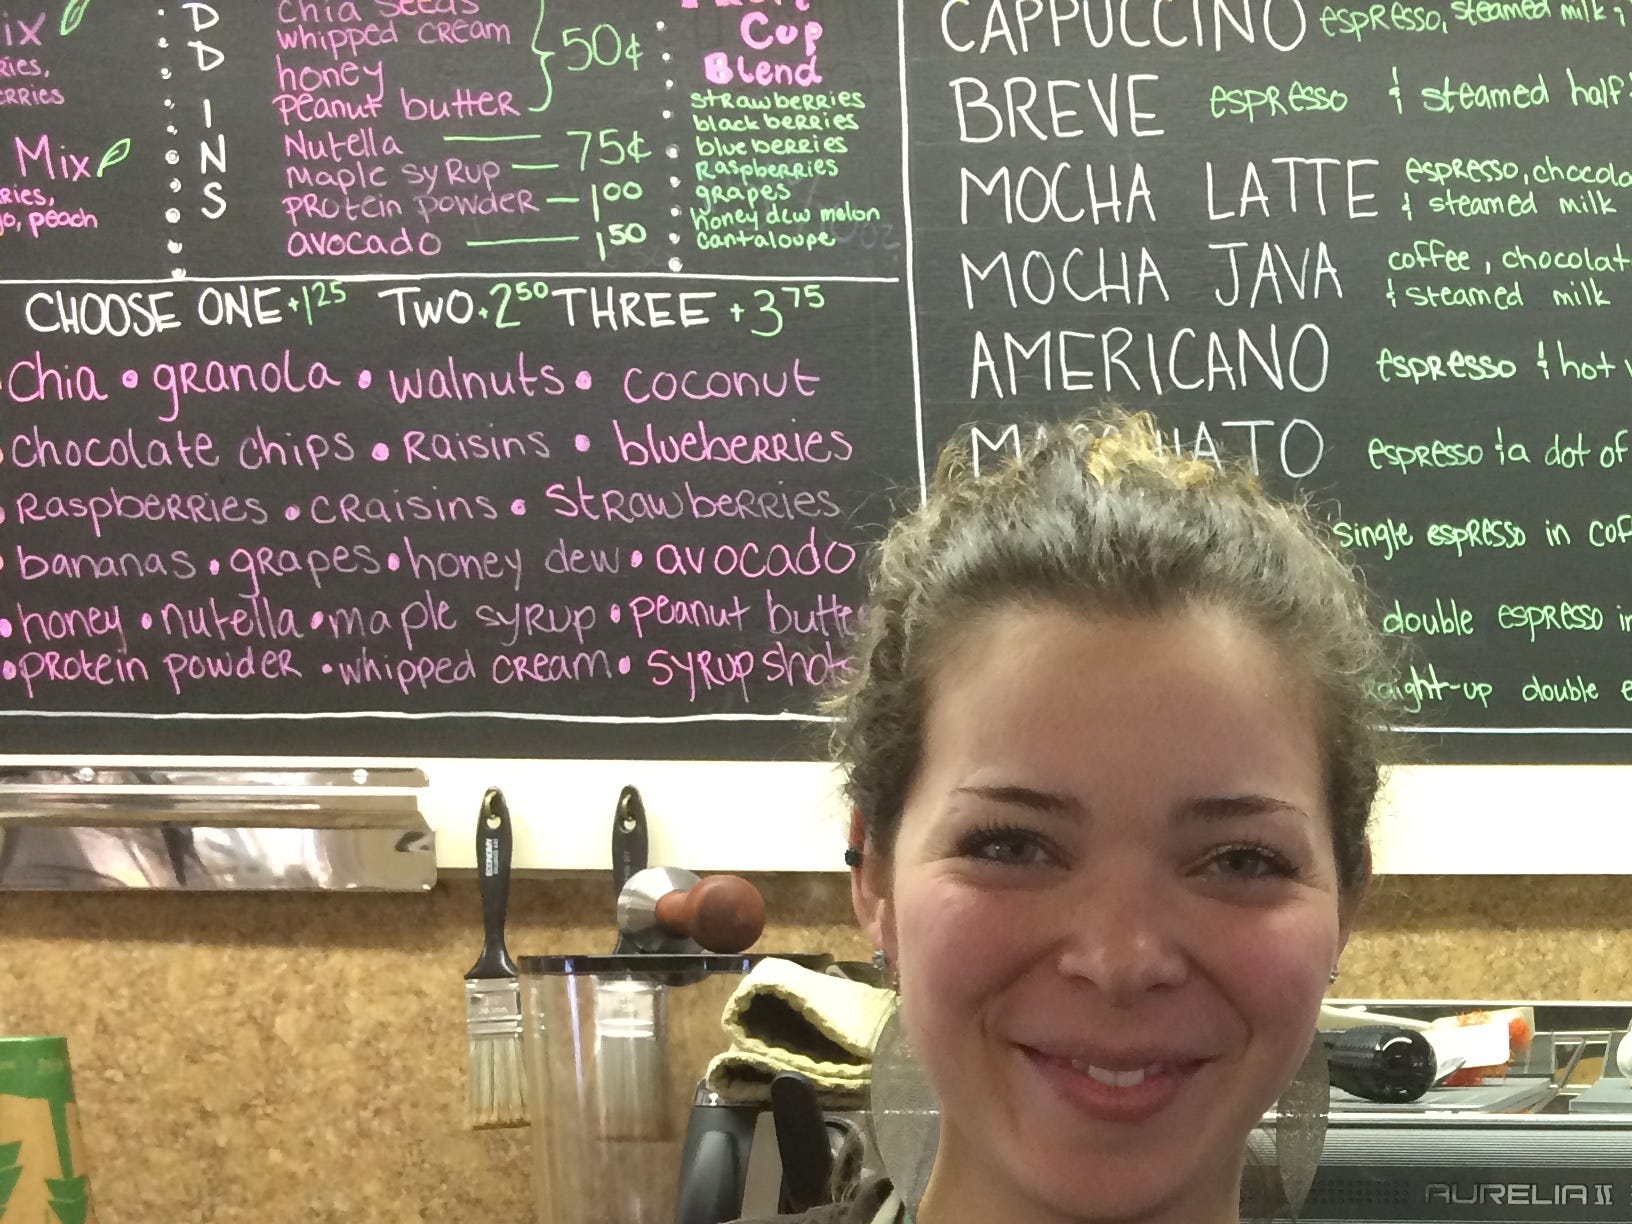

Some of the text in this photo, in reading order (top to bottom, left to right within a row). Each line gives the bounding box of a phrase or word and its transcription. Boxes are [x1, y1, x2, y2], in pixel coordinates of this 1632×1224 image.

[277, 19, 511, 59] whipped cream
[740, 11, 823, 56] Cup
[941, 0, 1307, 55] CAPPUCCINO
[277, 54, 383, 98] honey
[704, 52, 823, 86] Blend
[273, 88, 520, 126] Peanut butter
[690, 89, 866, 109] strawberries
[950, 73, 1164, 142] BREVE
[1210, 81, 1347, 122] espresso
[1422, 73, 1549, 112] steamed
[15, 134, 91, 181] Mix
[284, 129, 402, 157] Nutella
[284, 197, 401, 226] protein
[417, 187, 539, 225] powder
[696, 182, 791, 216] grapes
[961, 157, 1379, 225] MOCHA LATTE
[1429, 189, 1617, 217] steamed milk
[29, 207, 98, 238] peach
[821, 205, 879, 222] melon
[288, 229, 441, 257] avocado
[697, 229, 836, 249] cantaloupe
[961, 241, 1342, 309] MOCHA JAVA
[1406, 279, 1610, 309] steamed milk
[25, 291, 181, 337] CHOOSE
[198, 286, 282, 328] ONE
[378, 287, 474, 328] TWO
[552, 286, 717, 331] THREE
[970, 323, 1329, 399] AMERICANO
[1376, 347, 1516, 384] espresso
[1557, 340, 1615, 379] hot
[153, 349, 341, 423] granola
[390, 350, 564, 404] walnuts
[623, 358, 819, 404] coconut
[12, 425, 219, 469] chocolate
[239, 425, 354, 471] chips
[612, 419, 852, 466] blueberries
[1368, 438, 1483, 475] espresso
[1544, 433, 1591, 468] dot
[1601, 429, 1628, 468] of
[310, 486, 497, 523] craisins
[546, 475, 840, 524] strawberries
[1427, 519, 1526, 557] espresso
[1546, 520, 1570, 546] in
[17, 526, 855, 598] bananas grapes honey dew avocado
[18, 589, 750, 654] honey nutella maple syrup peanut
[1383, 599, 1473, 636] double
[1499, 602, 1602, 643] espresso
[19, 649, 148, 699] protein
[164, 646, 301, 695] powder
[339, 647, 476, 695] whipped
[492, 649, 611, 684] cream
[647, 649, 753, 702] syrup
[1522, 674, 1599, 702] double
[1424, 1182, 1588, 1205] AURELIA
